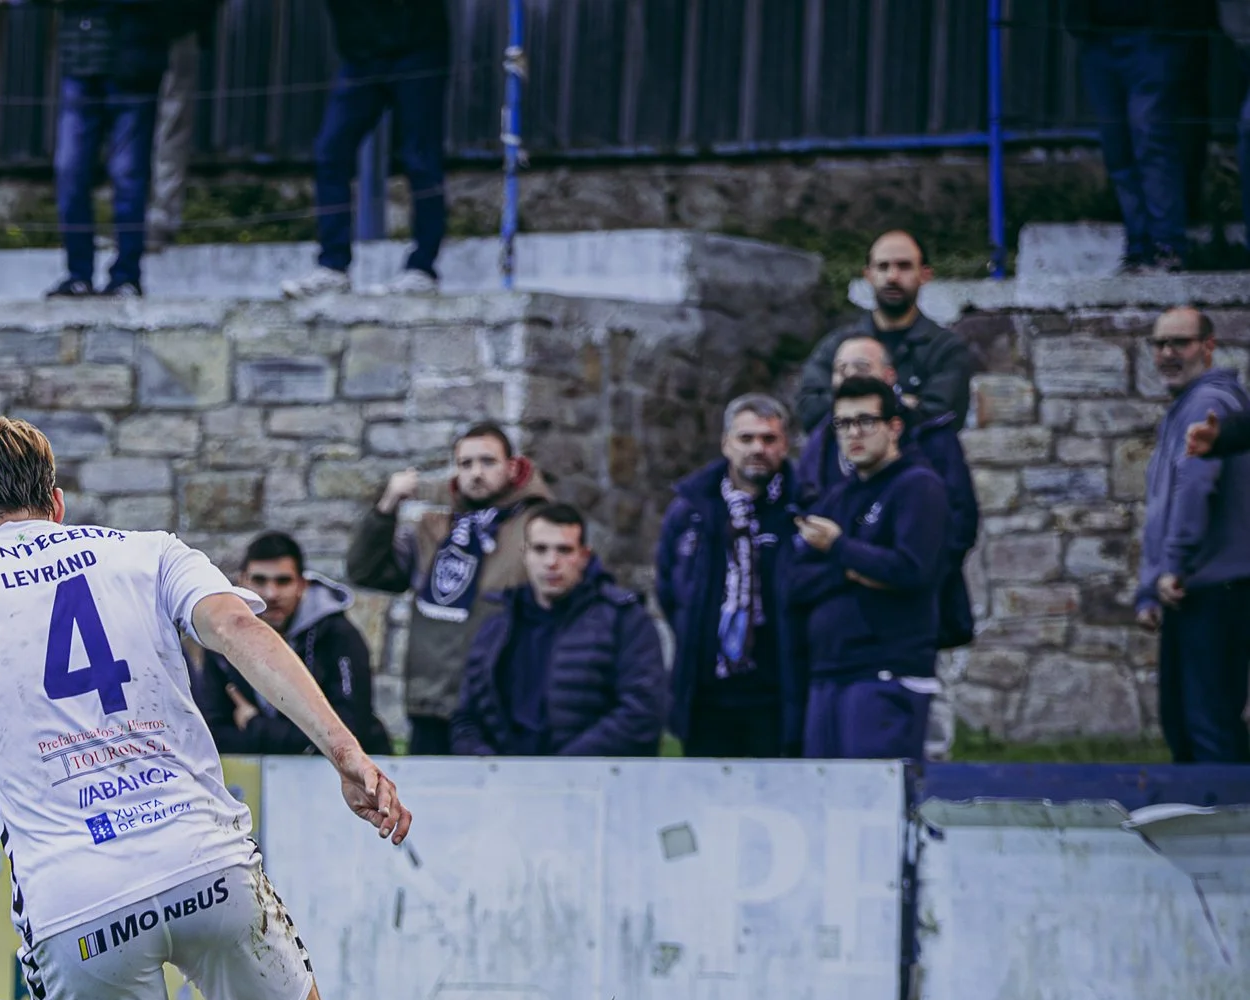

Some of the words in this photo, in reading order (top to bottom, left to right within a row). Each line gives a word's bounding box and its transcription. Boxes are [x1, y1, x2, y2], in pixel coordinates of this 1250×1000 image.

[0, 549, 97, 589] LEVRAND
[43, 573, 131, 716] 4
[127, 719, 166, 733] Hierros
[88, 767, 178, 805] ABANCA
[113, 798, 165, 822] XUNTA
[118, 818, 138, 833] DE
